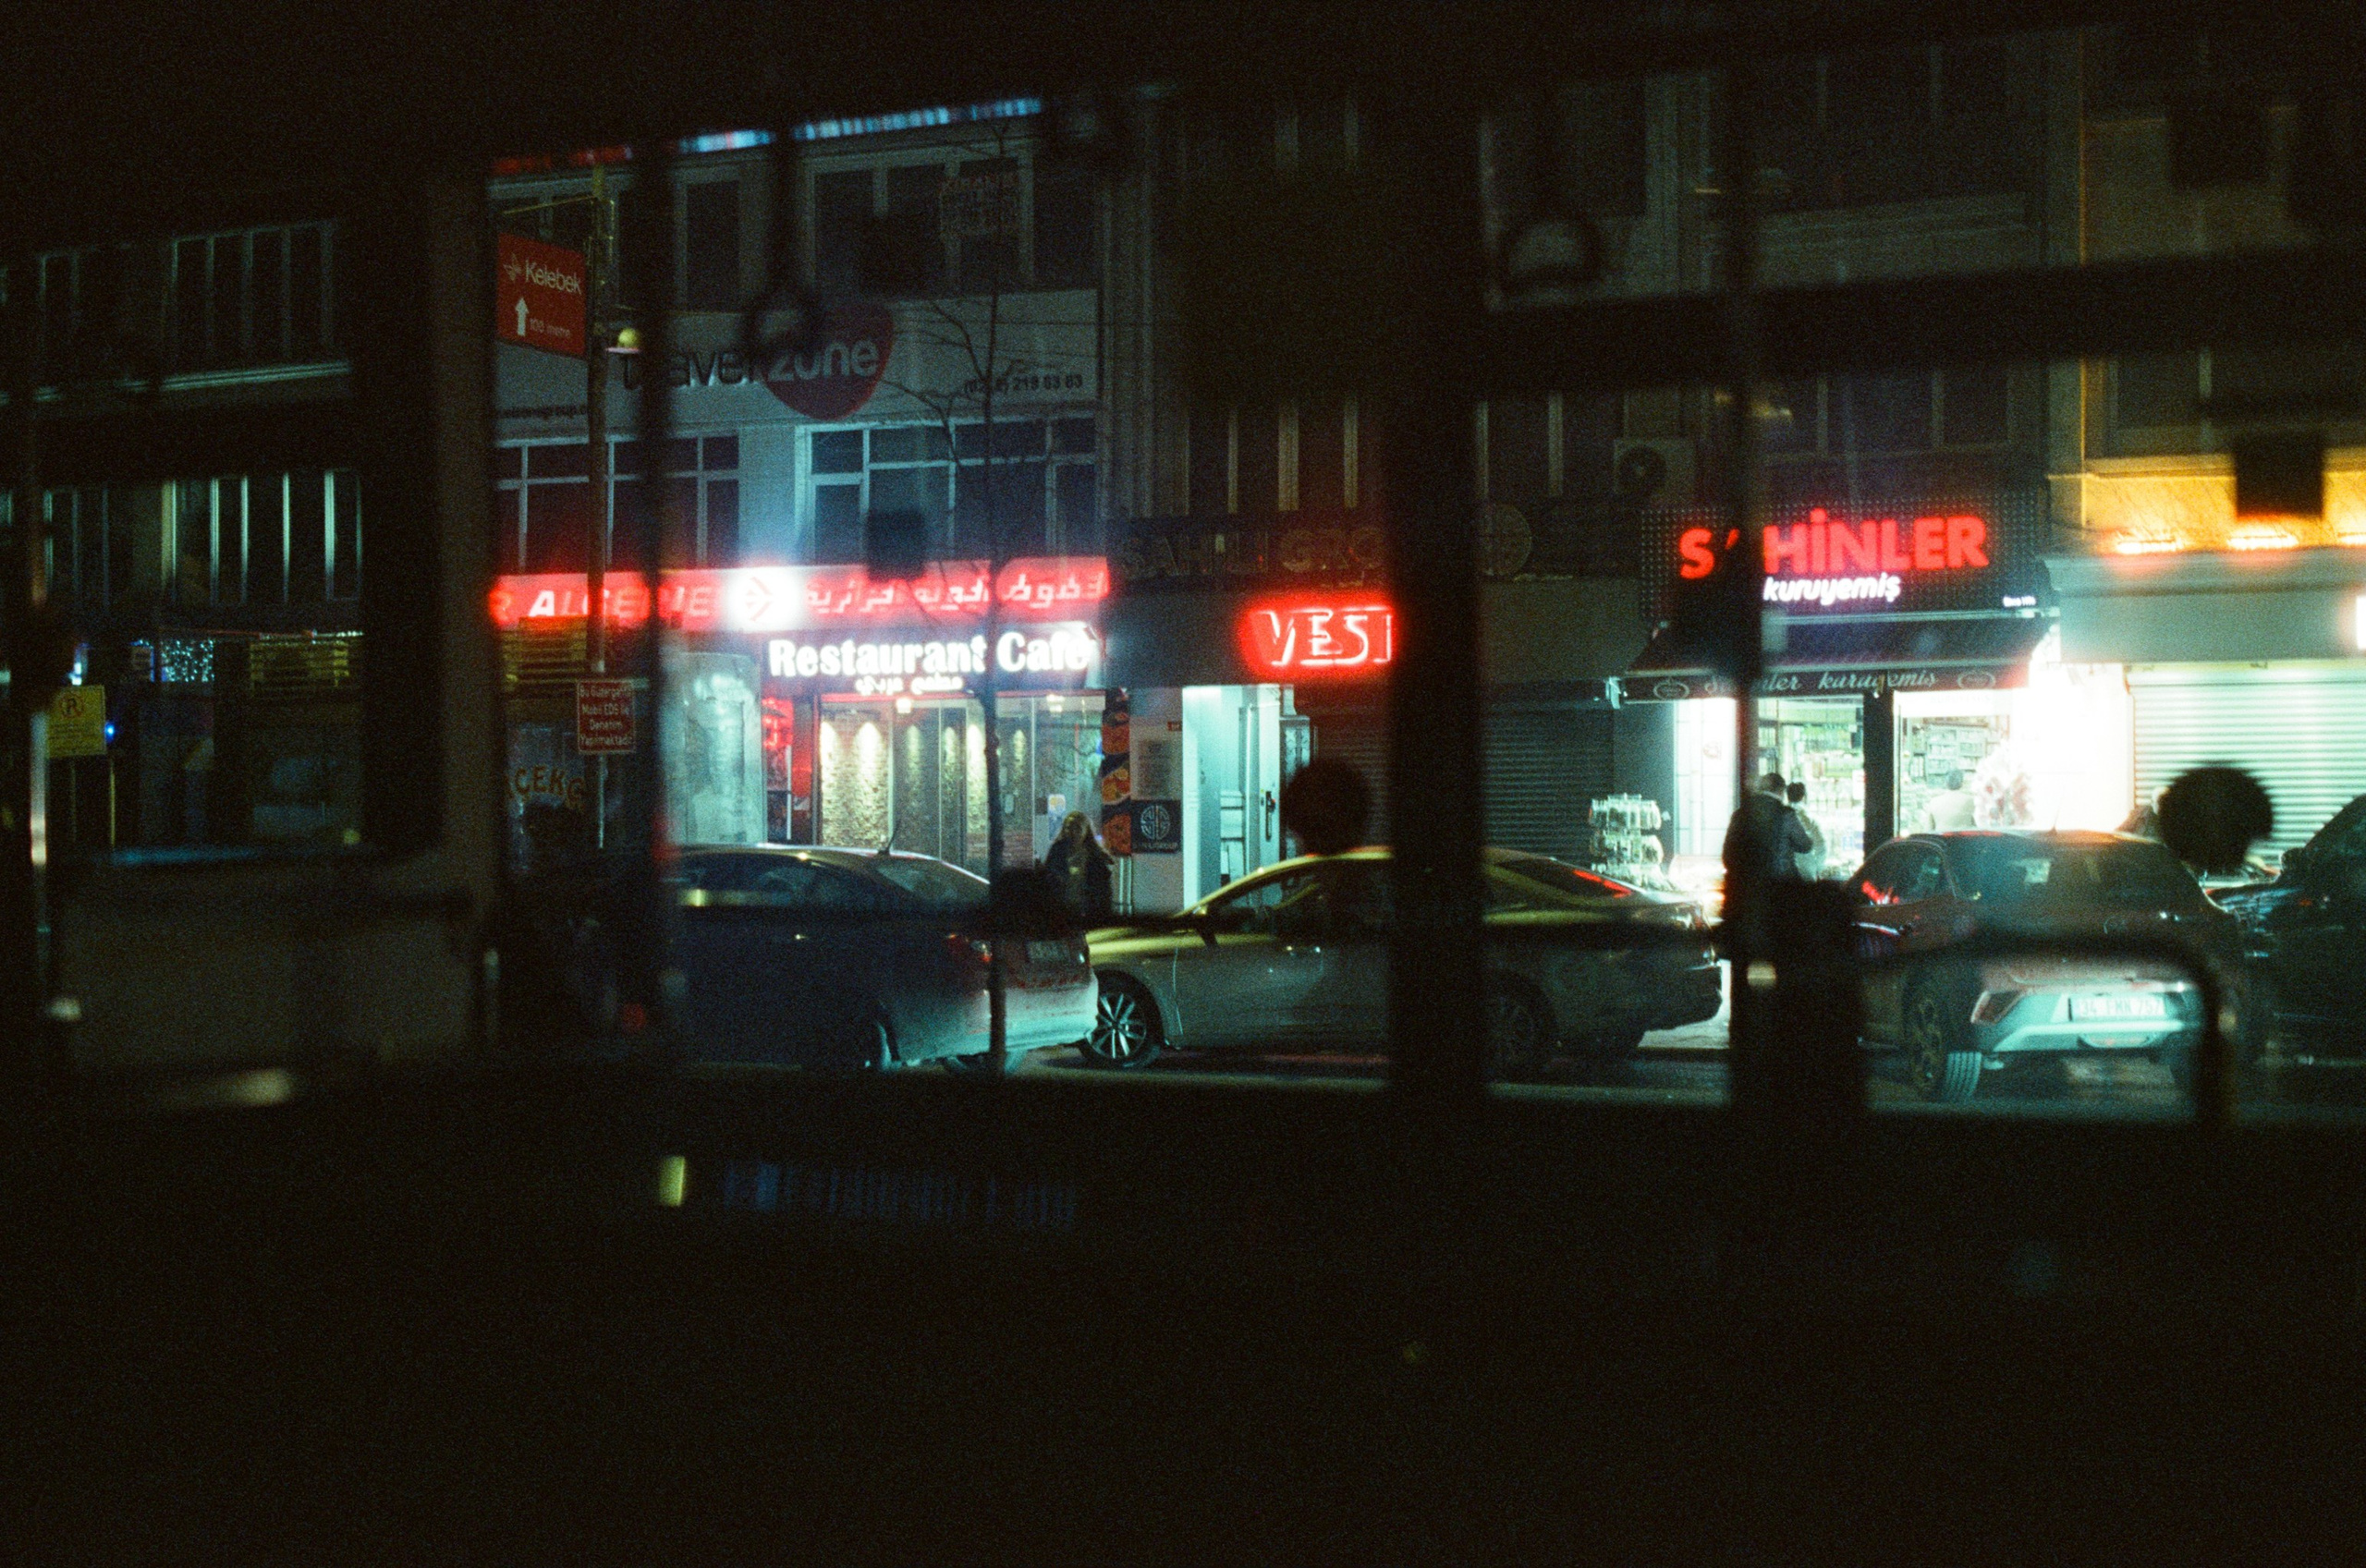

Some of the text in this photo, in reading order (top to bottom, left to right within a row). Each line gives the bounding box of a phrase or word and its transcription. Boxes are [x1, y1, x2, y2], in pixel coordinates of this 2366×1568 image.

[524, 258, 583, 296] Kelebek
[1763, 573, 1900, 605] kuruyemiş
[769, 635, 988, 677] Restaurant
